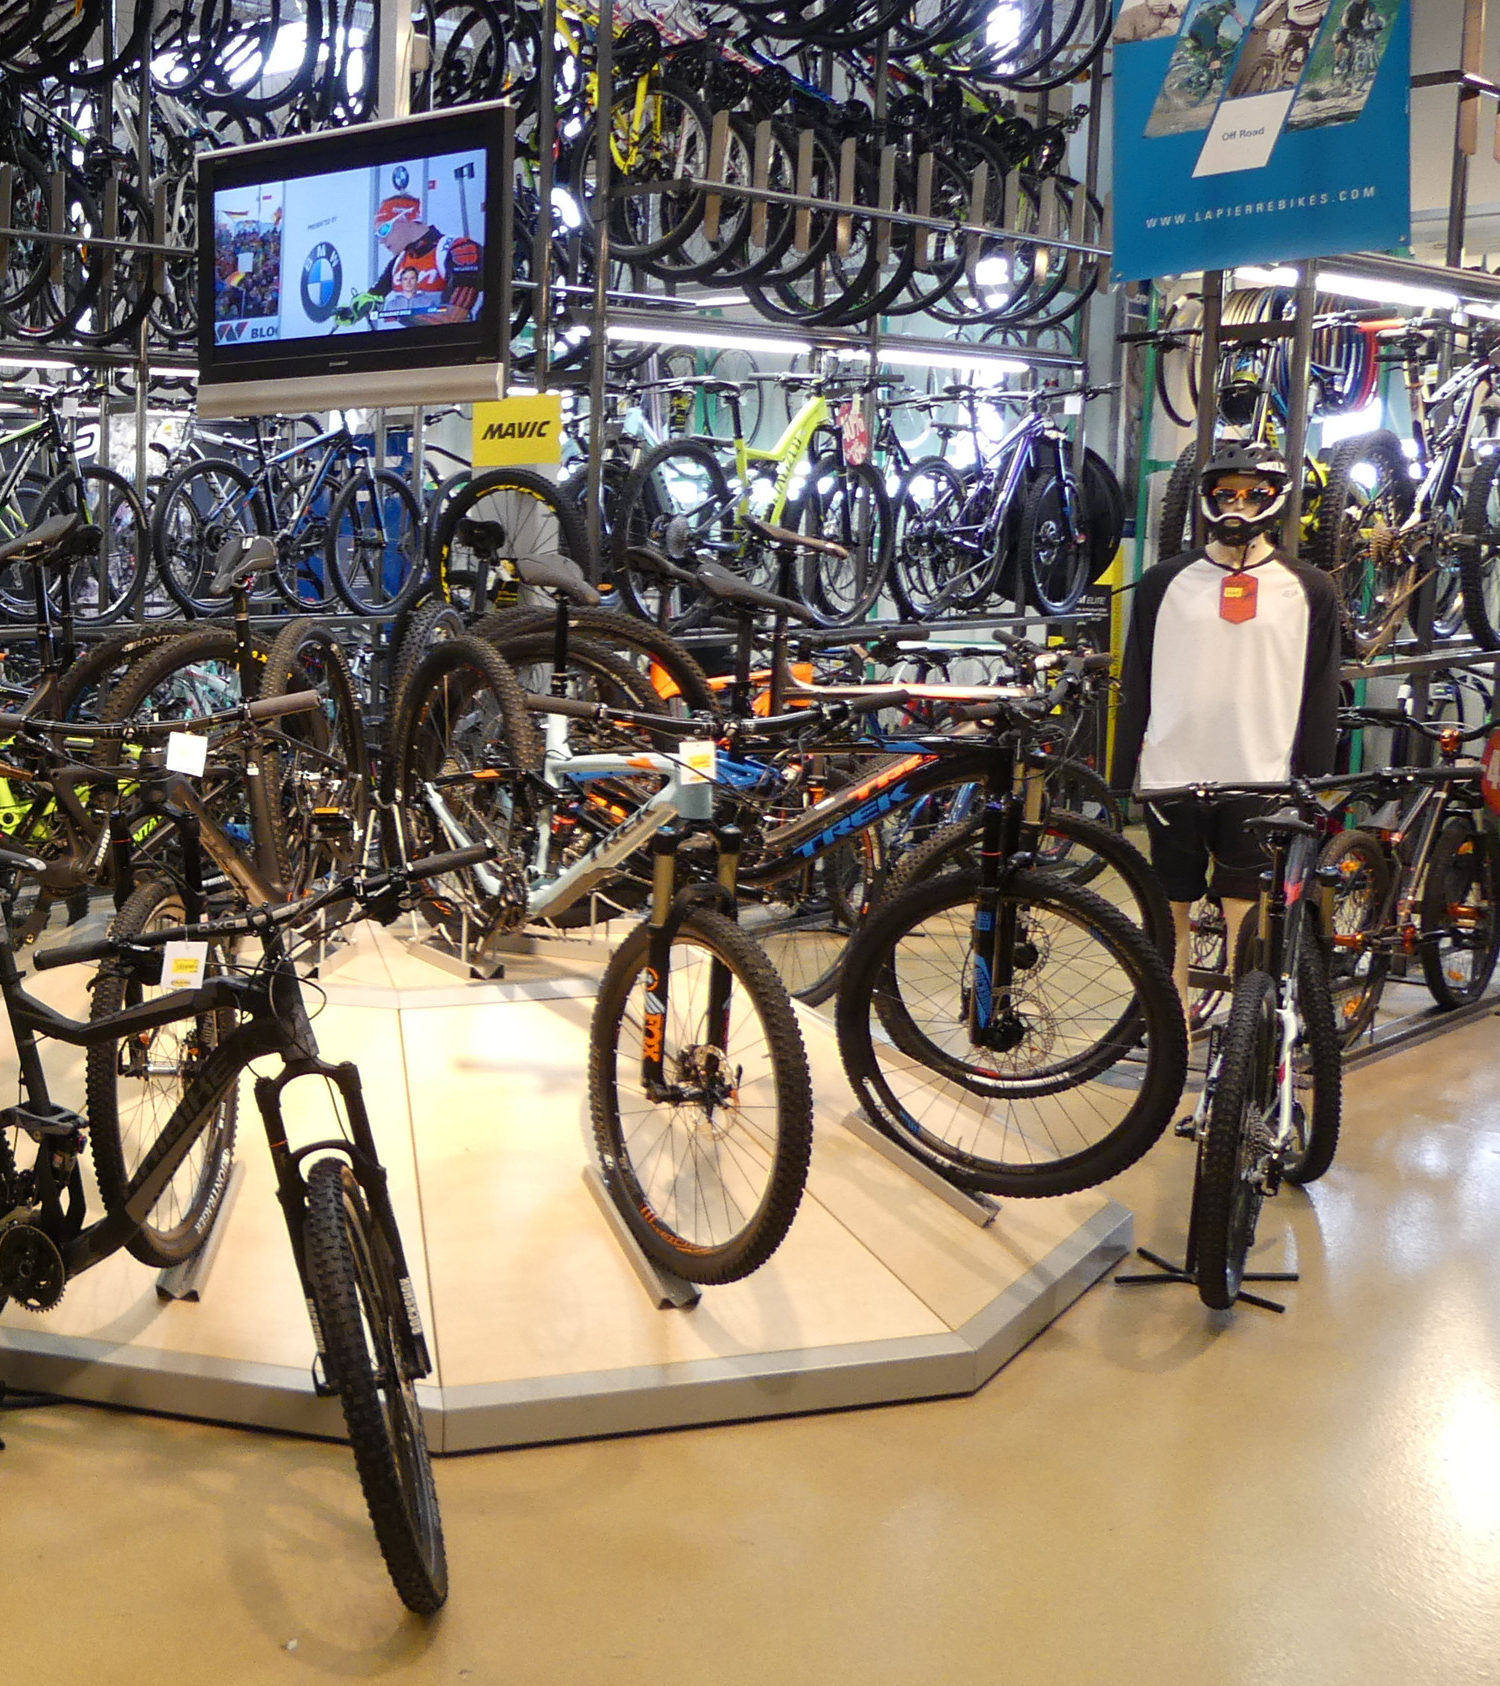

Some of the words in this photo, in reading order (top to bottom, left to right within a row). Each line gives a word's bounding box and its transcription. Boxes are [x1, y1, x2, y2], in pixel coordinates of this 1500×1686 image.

[1222, 131, 1237, 141] Off
[1240, 127, 1265, 139] Road
[1146, 186, 1376, 228] WWW.LAPIERREBIKES.COM
[481, 420, 552, 441] MAVIC
[793, 781, 912, 858] TREK
